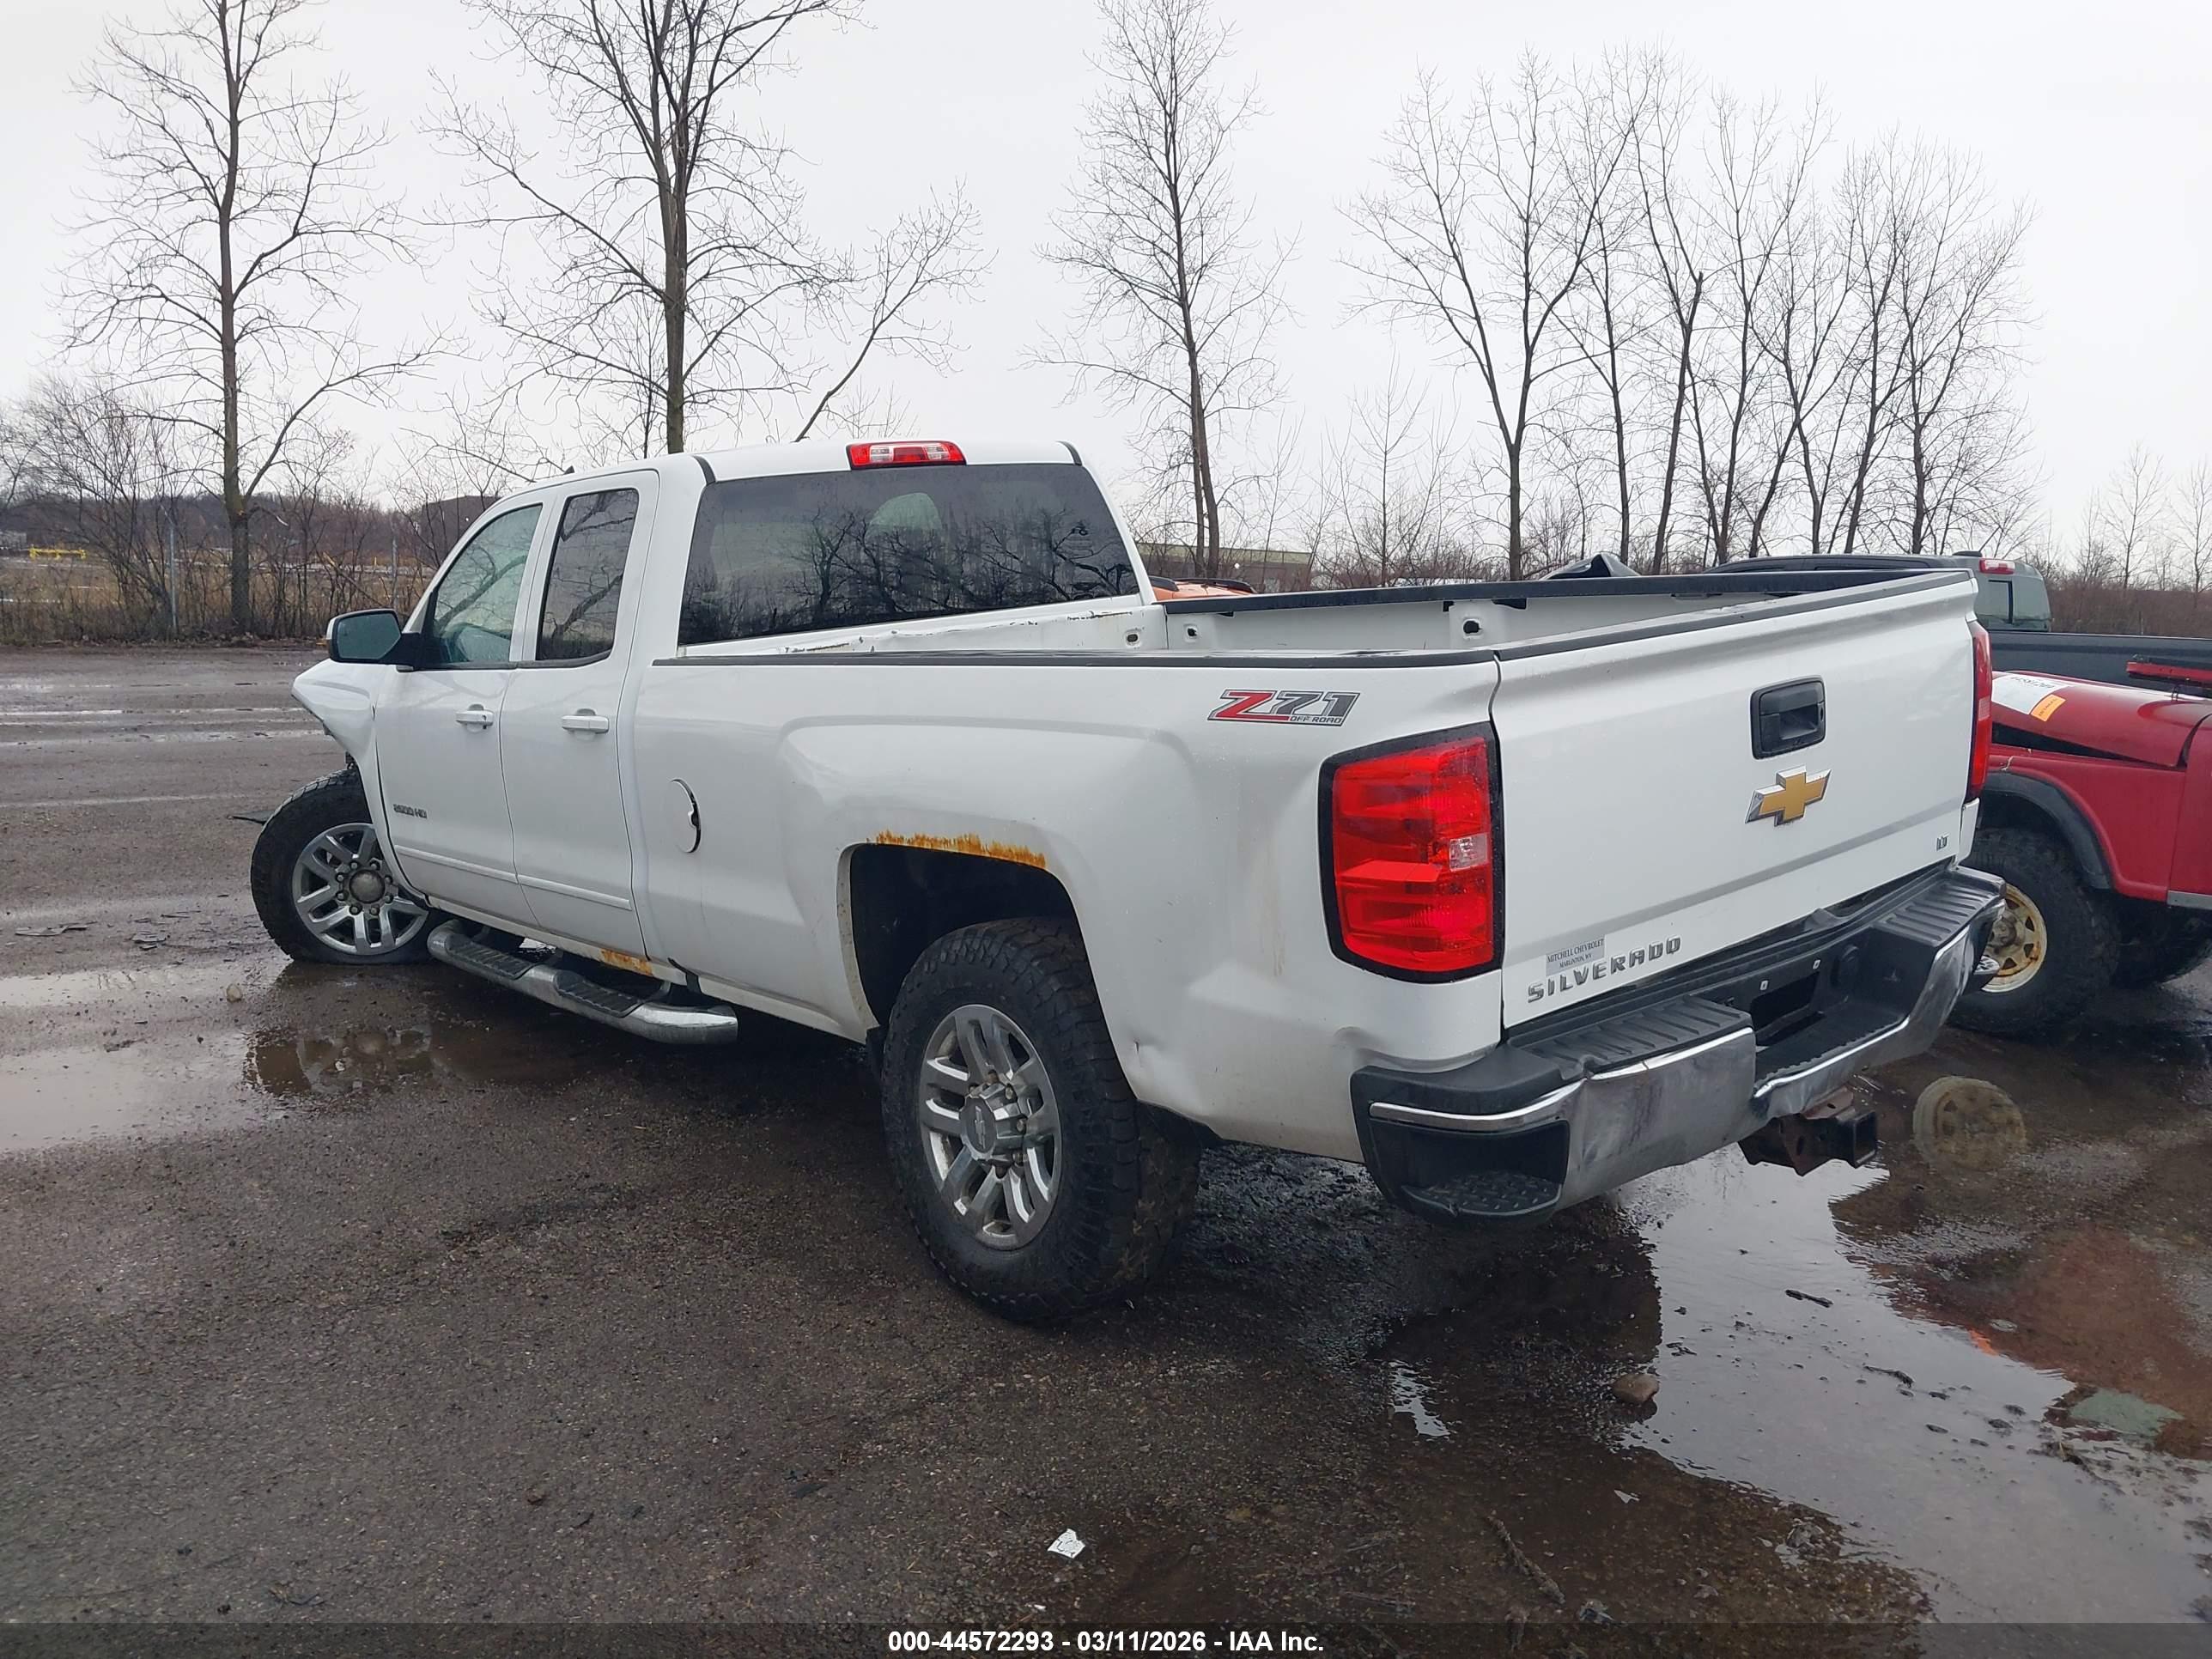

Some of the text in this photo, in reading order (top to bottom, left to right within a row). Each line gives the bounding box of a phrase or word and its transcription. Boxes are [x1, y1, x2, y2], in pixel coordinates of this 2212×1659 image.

[1207, 689, 1360, 726] Z71
[1547, 938, 1604, 962] MITCHELL CHEVROLET
[1528, 937, 1680, 1003] SILVERADO
